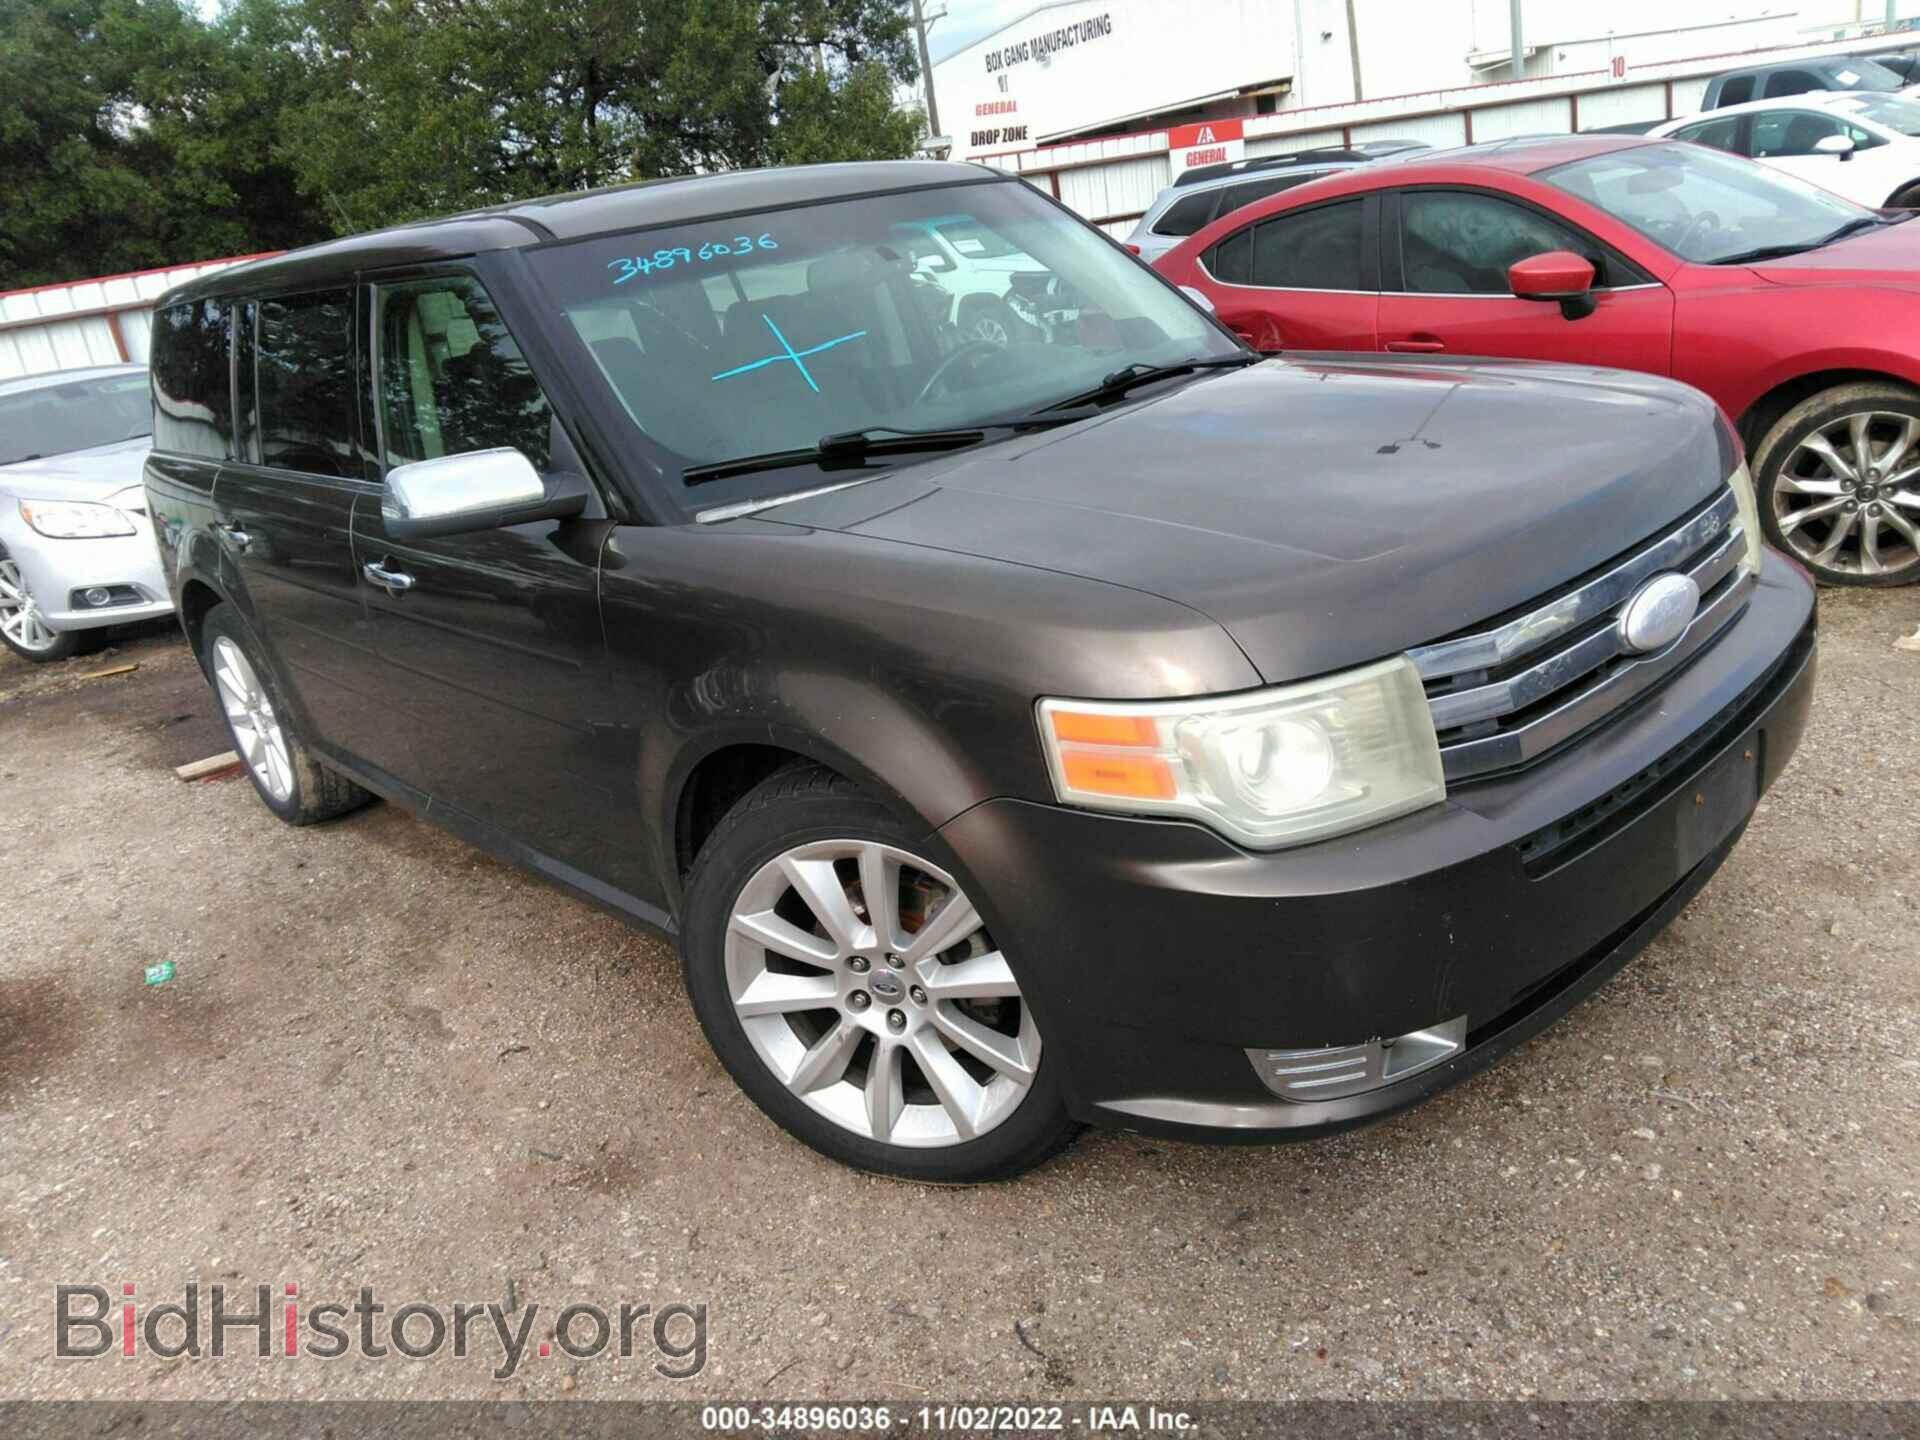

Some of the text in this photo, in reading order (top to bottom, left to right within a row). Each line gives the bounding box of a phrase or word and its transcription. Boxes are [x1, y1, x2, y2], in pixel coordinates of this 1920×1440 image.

[985, 13, 1112, 73] BOX GANG MANUFACTURING
[1611, 55, 1625, 78] 10
[975, 100, 1018, 116] GENERAL
[971, 125, 1028, 147] DROP ZONE
[1186, 147, 1227, 167] GENERAL
[607, 233, 778, 284] 34896036
